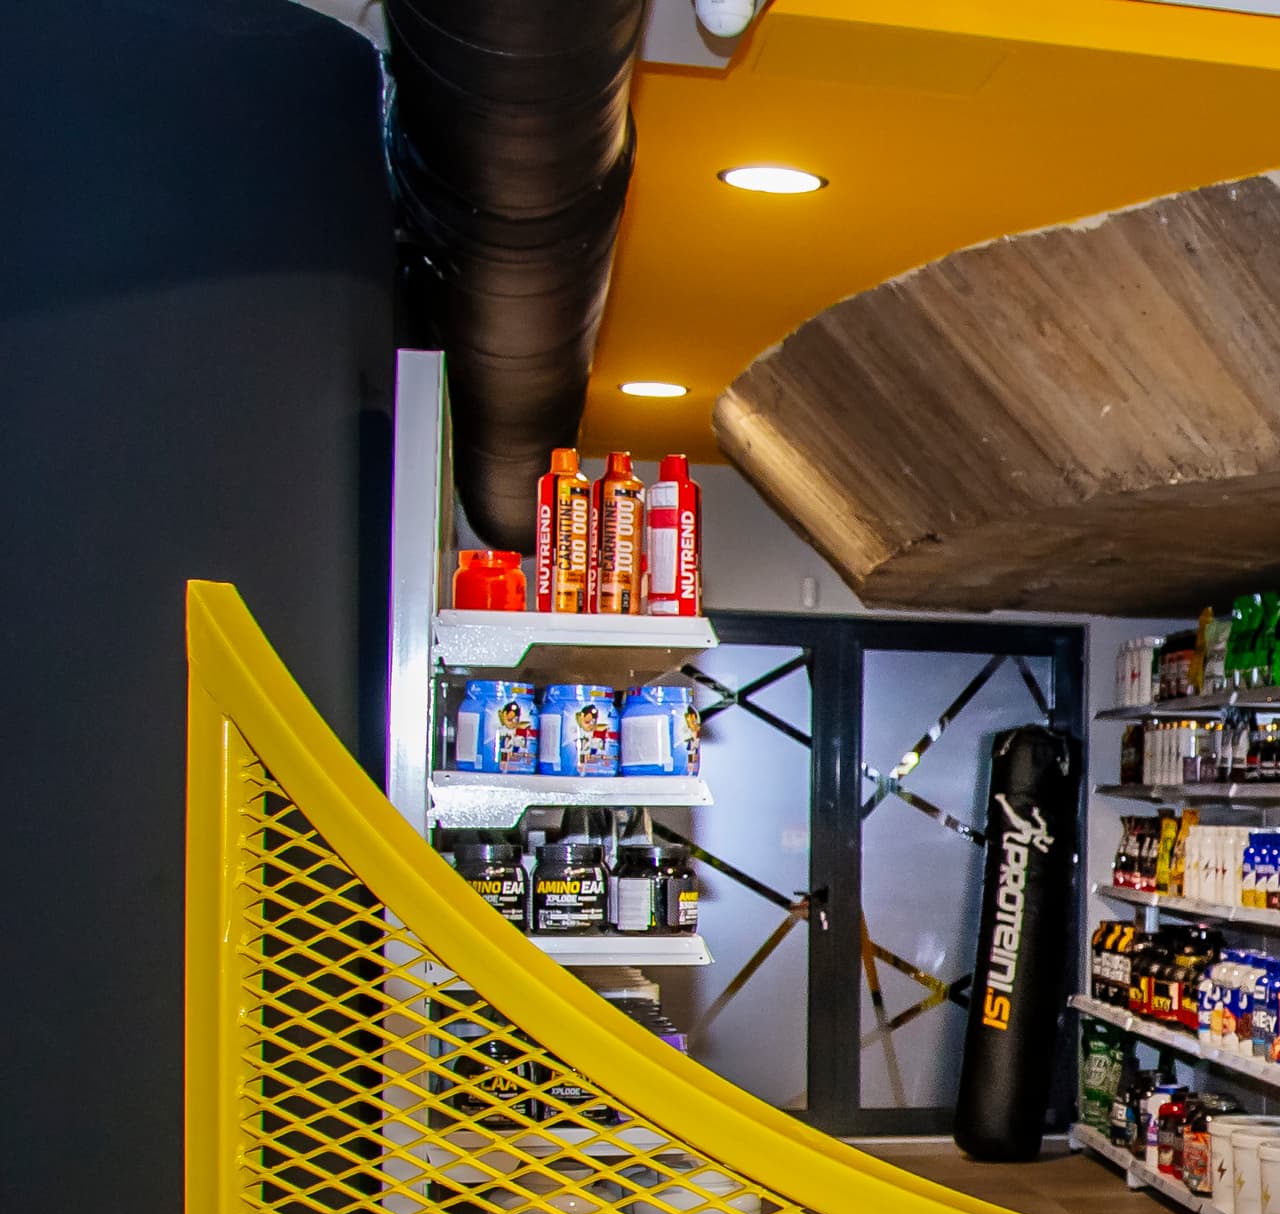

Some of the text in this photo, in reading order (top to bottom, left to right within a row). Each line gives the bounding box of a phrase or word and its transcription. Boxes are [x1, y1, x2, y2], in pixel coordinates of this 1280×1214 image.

[539, 504, 551, 594] NUTREND
[559, 498, 572, 572] CARNITINE
[603, 500, 618, 572] CARNITINE
[681, 511, 695, 599] NUTREND
[467, 880, 501, 894] MINO
[536, 880, 581, 894] AMINO
